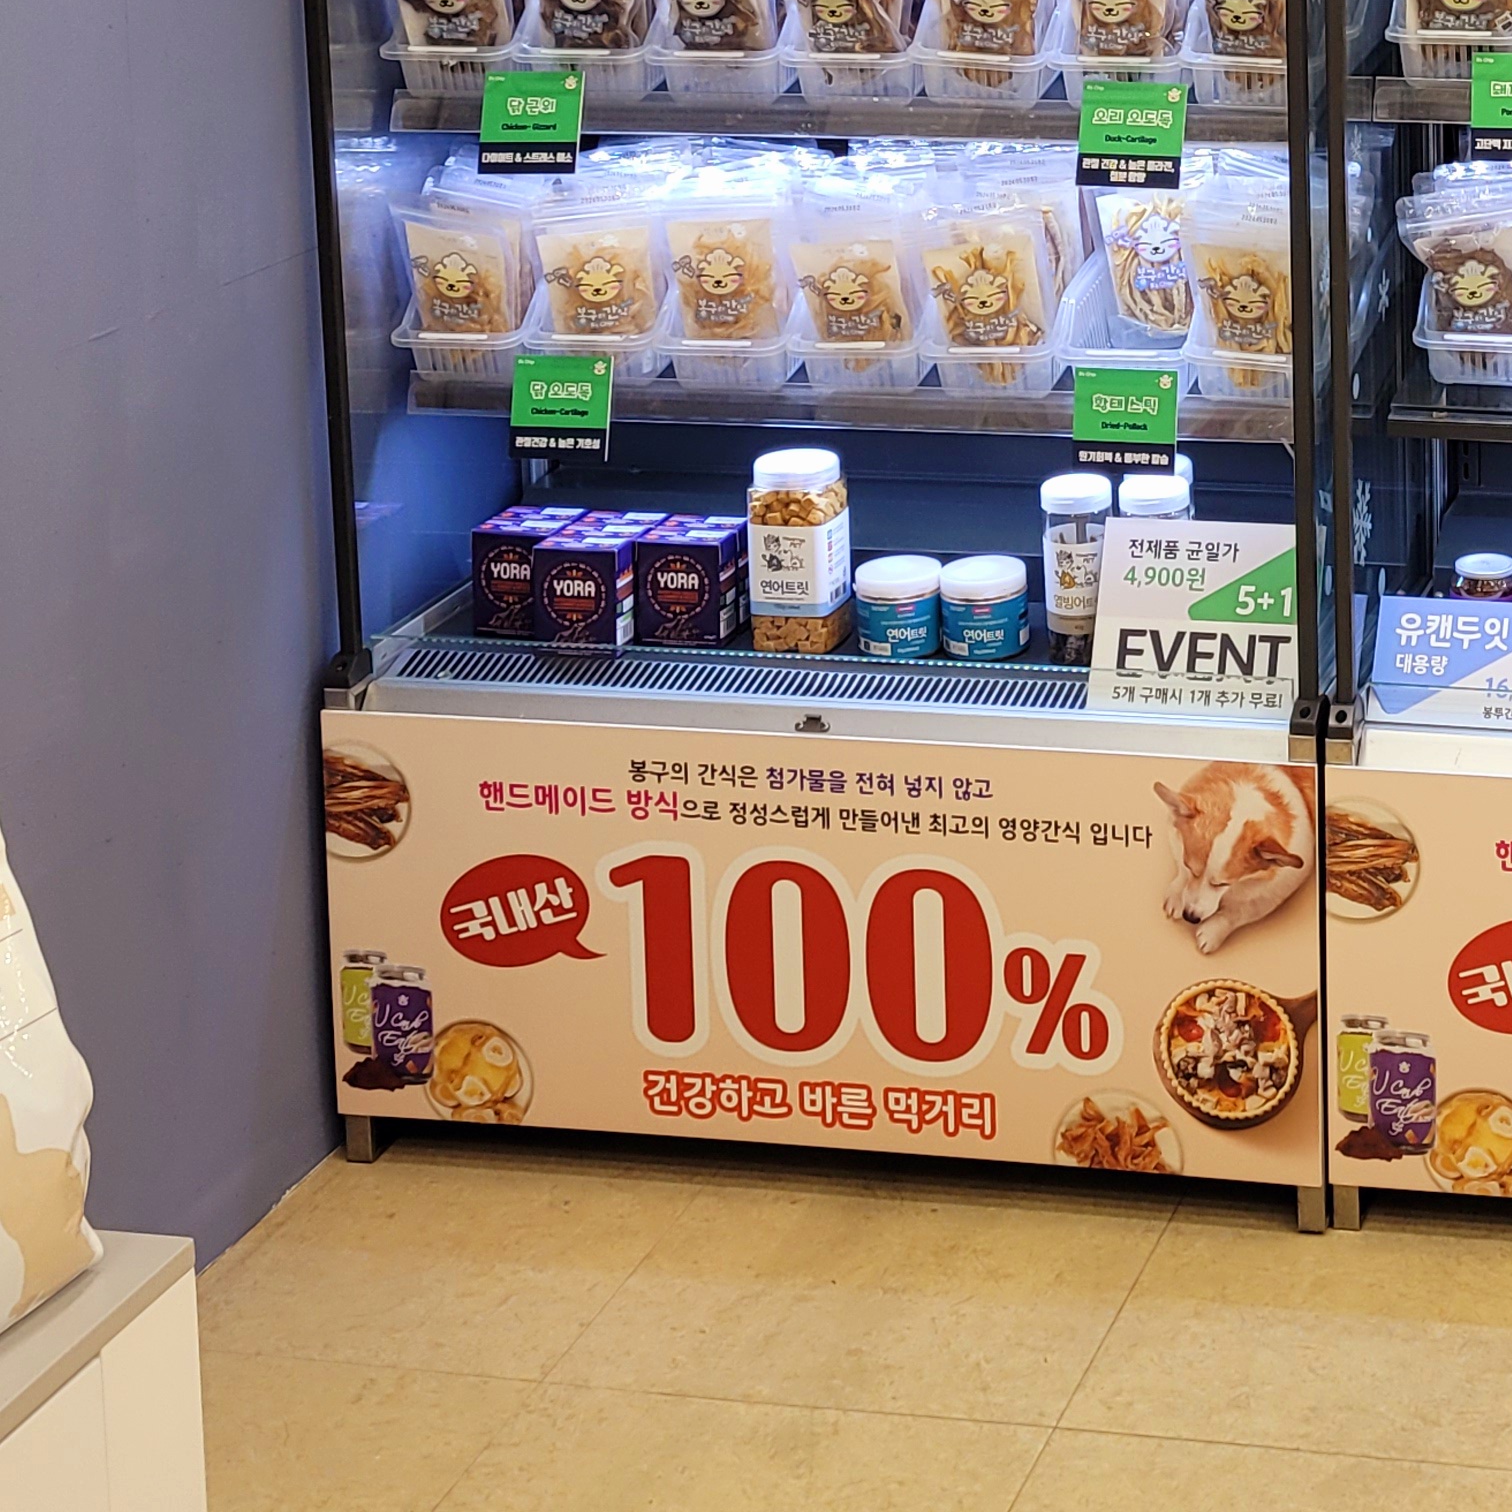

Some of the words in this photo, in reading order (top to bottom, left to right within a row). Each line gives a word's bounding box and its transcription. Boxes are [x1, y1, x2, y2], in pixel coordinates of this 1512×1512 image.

[526, 97, 556, 115] 근위
[1092, 108, 1124, 124] 오리
[1126, 109, 1173, 128] 오도독
[548, 382, 592, 401] 오도독
[1093, 393, 1125, 413] 황태
[1129, 539, 1180, 560] 전제품
[1185, 541, 1239, 563] 균일가
[490, 562, 531, 580] YORA
[657, 572, 699, 589] YORA
[1124, 565, 1206, 591] 4,900원
[553, 579, 596, 597] YORA
[760, 579, 809, 596] 연어트릿
[1236, 585, 1293, 617] 5+1
[886, 627, 927, 641] 연어트릿
[963, 629, 1004, 643] 연어트릿
[1395, 613, 1509, 651] 유캔두잇
[1116, 628, 1291, 684] EVENT
[1396, 654, 1448, 676] 대용량
[1112, 686, 1135, 703] 5개
[1140, 688, 1182, 705] 구매시
[1189, 690, 1210, 706] 1개
[1216, 691, 1245, 708] 추가
[1249, 693, 1282, 708] 무료!
[628, 759, 689, 785] 봉구의
[697, 763, 758, 788] 간식은
[766, 766, 847, 794] 첨가물을
[855, 772, 894, 796] 전혀
[904, 774, 943, 799] 넣지
[952, 777, 993, 801] 않고
[479, 781, 616, 816] 핸드메이드
[626, 790, 721, 821] 방식으로
[729, 801, 830, 830] 정성스럽게
[839, 807, 920, 834] 만들어낸
[928, 813, 989, 839] 최고의
[999, 816, 1081, 844] 영양간식
[1090, 822, 1152, 849] 입니다
[448, 876, 578, 944] 국내산
[608, 854, 1110, 1062] 100%
[645, 1069, 792, 1120] 건강하고
[800, 1082, 875, 1131] 바른
[884, 1089, 997, 1140] 먹거리
